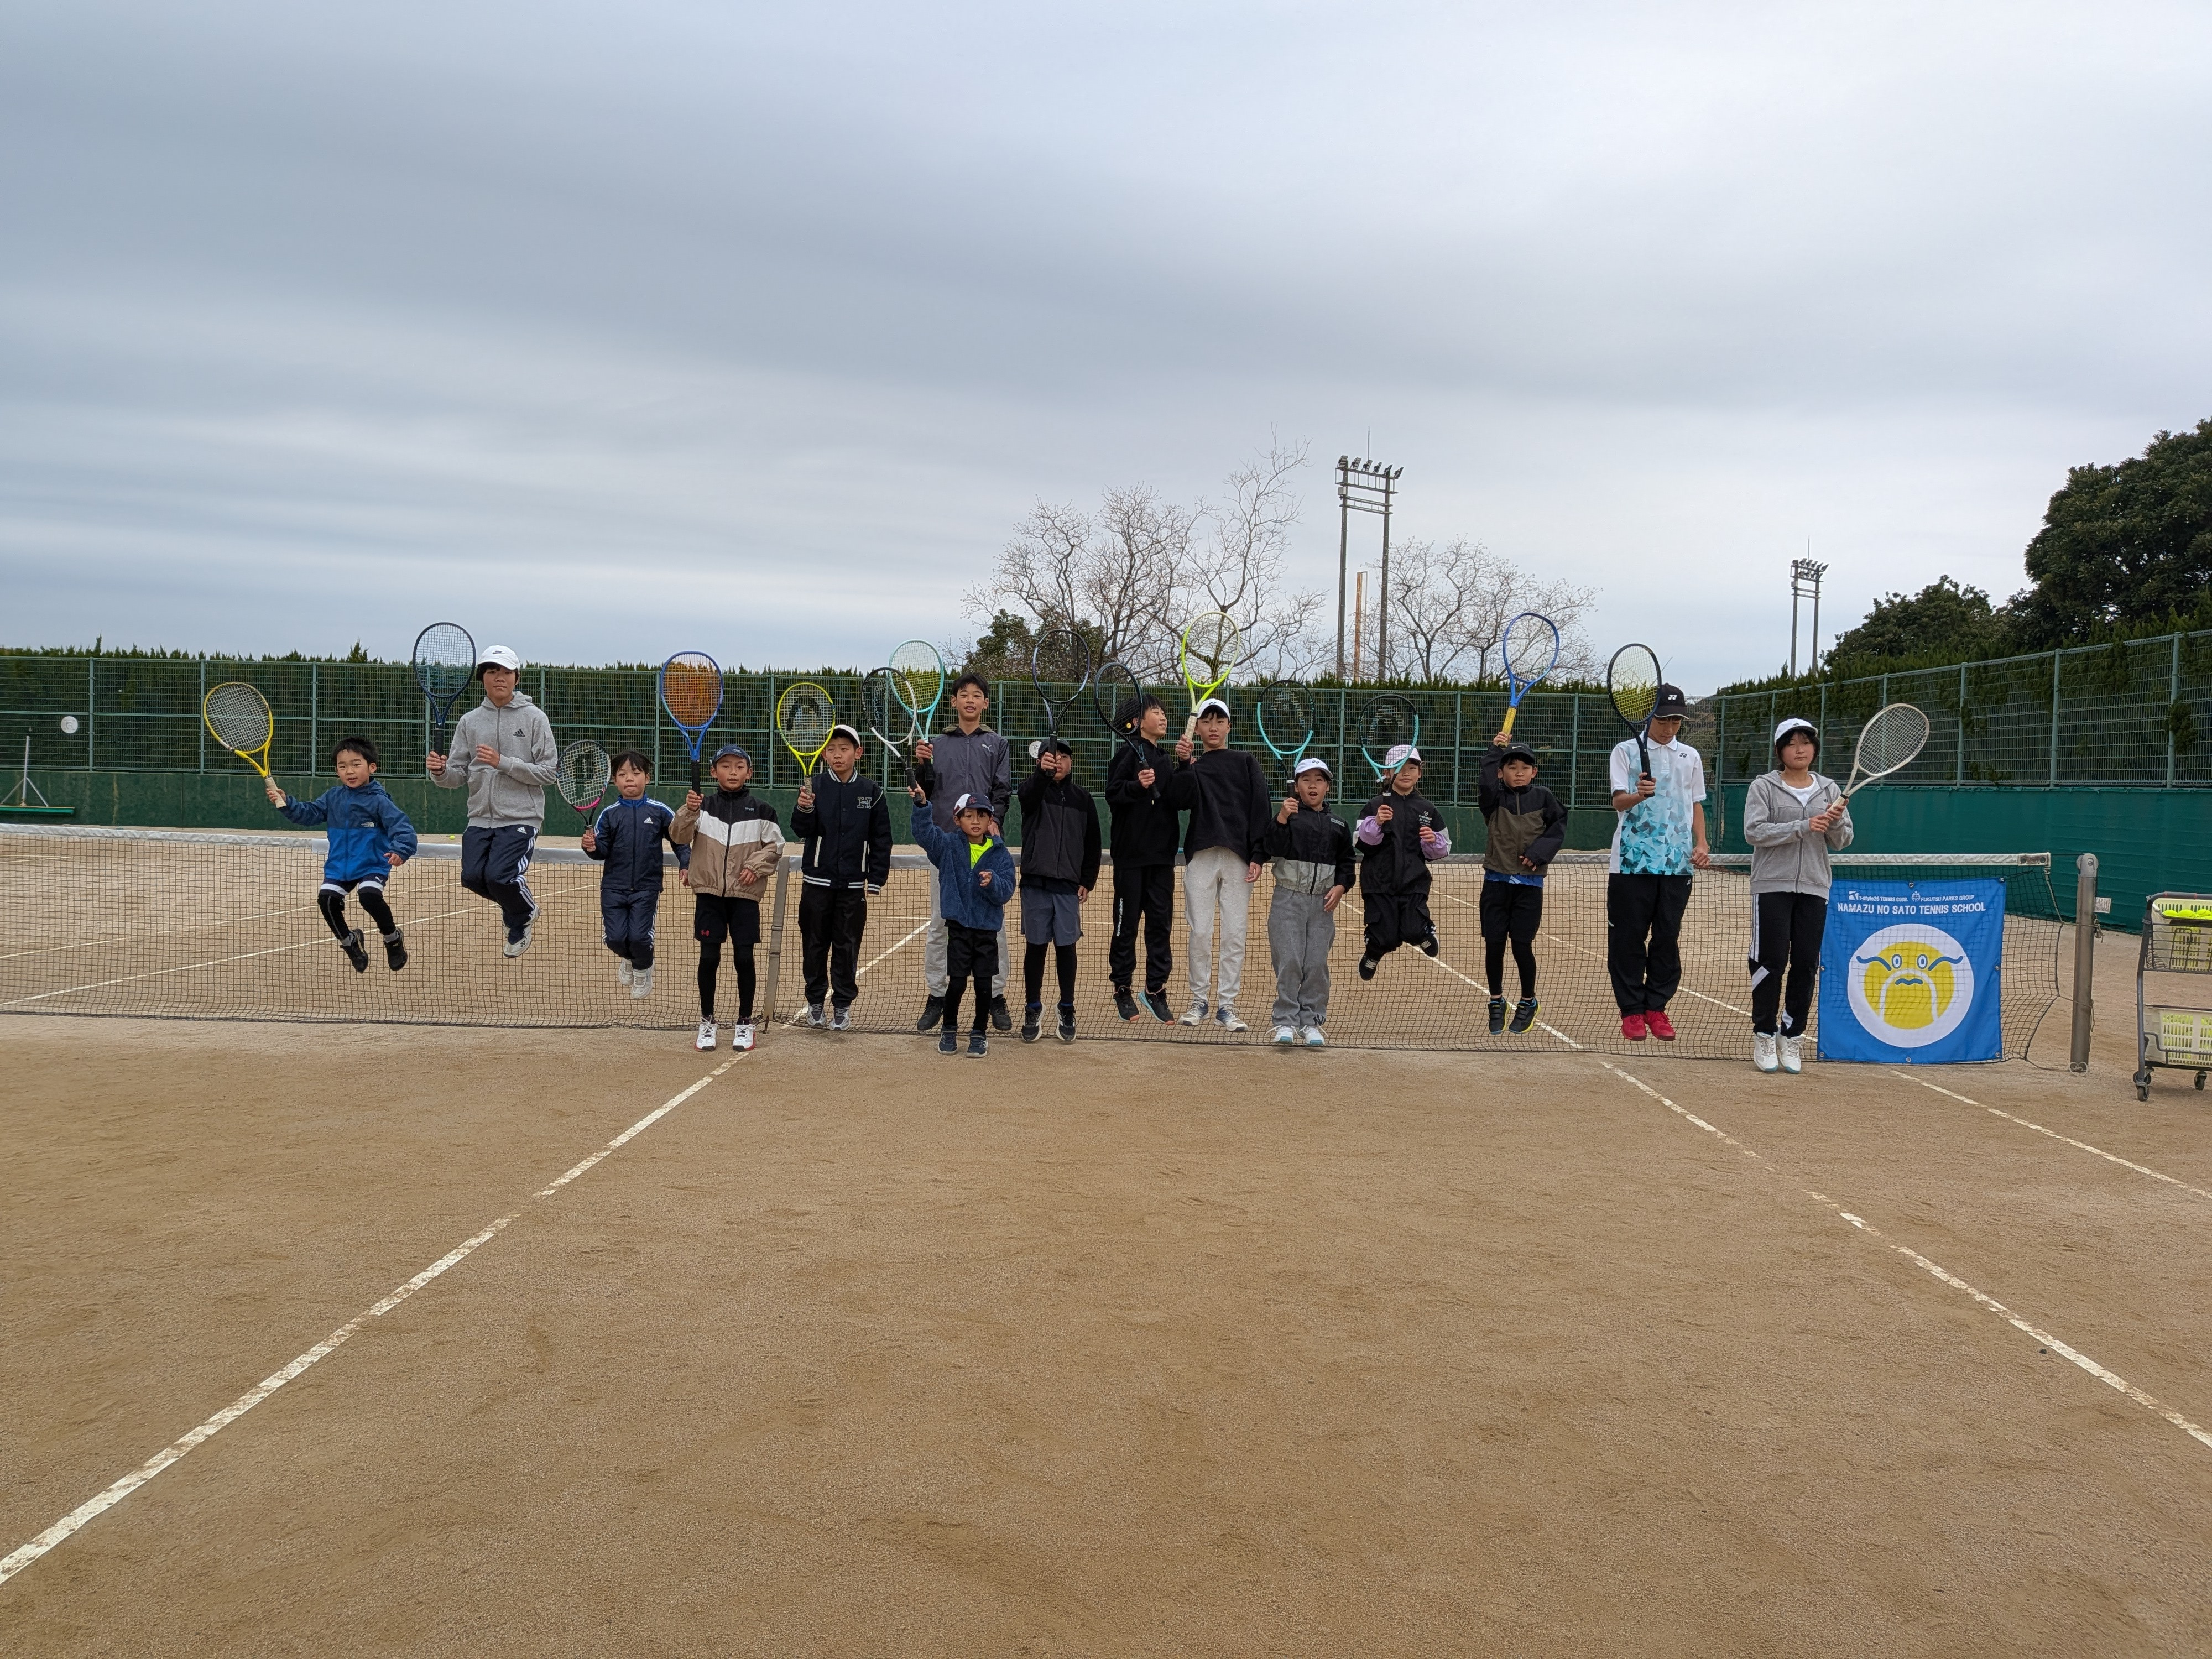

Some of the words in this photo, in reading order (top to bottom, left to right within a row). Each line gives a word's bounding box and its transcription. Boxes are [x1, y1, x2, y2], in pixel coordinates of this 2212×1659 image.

[1837, 902, 1875, 914] NAMAZU
[1876, 905, 1890, 914] NO
[1892, 905, 1917, 915] SATO
[1919, 905, 1949, 914] TENNIS
[1952, 902, 1986, 913] SCHOOL
